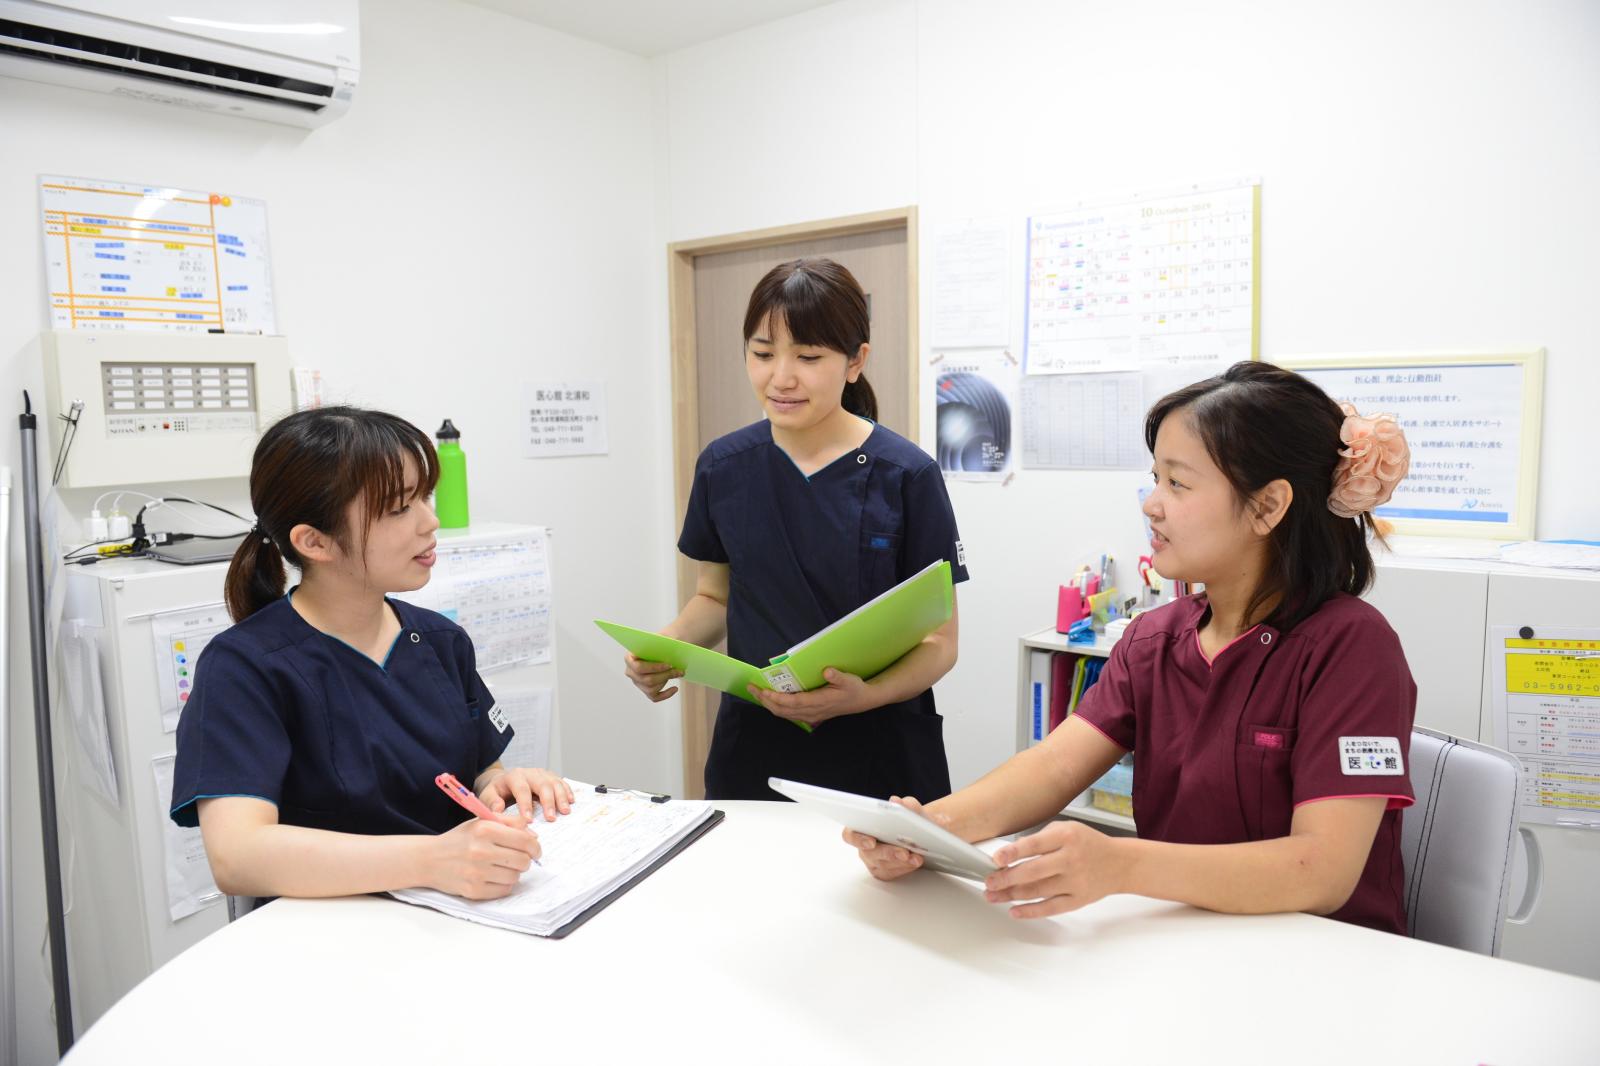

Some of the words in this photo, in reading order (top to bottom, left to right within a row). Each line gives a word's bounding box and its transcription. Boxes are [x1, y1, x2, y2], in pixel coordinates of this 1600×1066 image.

[1141, 207, 1153, 218] 10
[536, 390, 562, 401] 医心館
[565, 390, 589, 401] 北浦和
